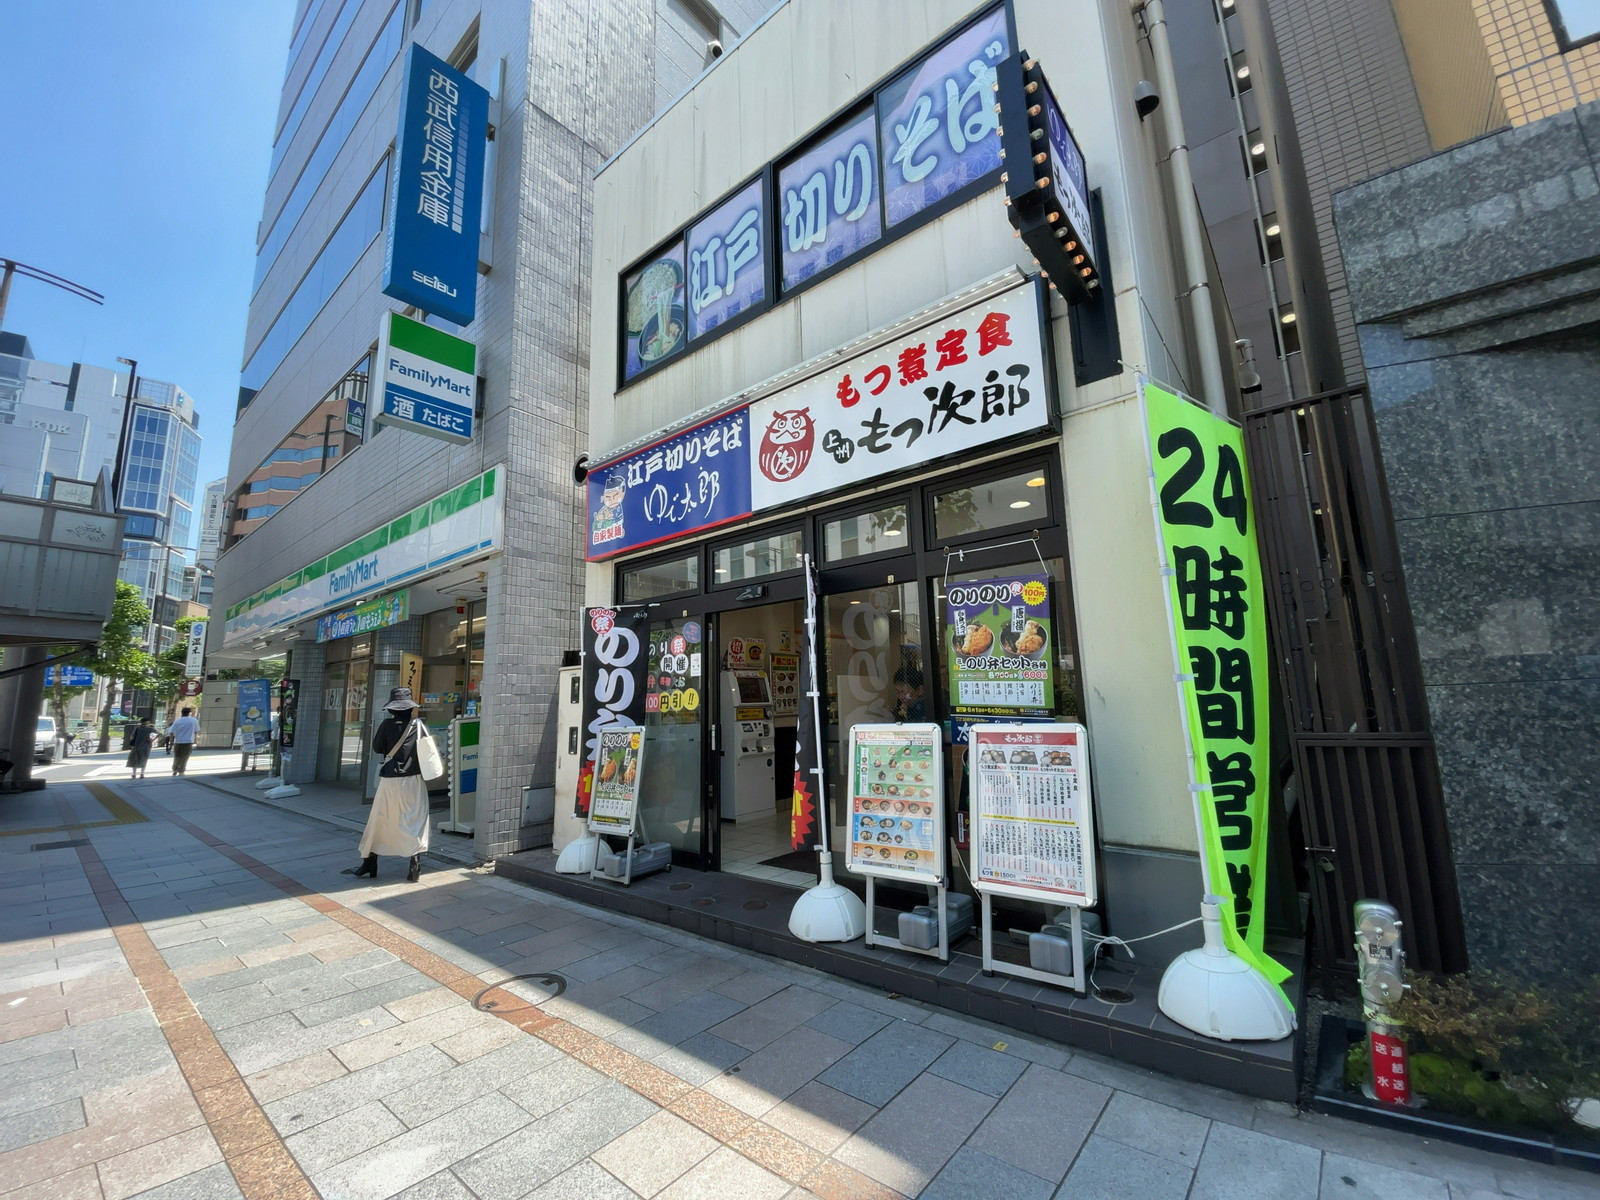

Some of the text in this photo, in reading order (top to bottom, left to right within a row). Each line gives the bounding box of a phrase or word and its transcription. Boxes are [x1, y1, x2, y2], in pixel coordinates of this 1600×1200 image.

[417, 67, 460, 227] 西武信用金庫
[389, 358, 471, 399] FamilyMart
[835, 311, 1013, 409] もつ煮定食
[391, 394, 465, 433] 酒 たばこ
[858, 363, 1030, 454] もつ次郎
[627, 418, 744, 489] 江戸切りそば
[643, 466, 721, 527] ゆで太郎
[593, 524, 623, 545] 自家製麺
[329, 553, 379, 596] FamilyMart
[949, 585, 1009, 605] のりのり
[664, 657, 686, 671] 開催
